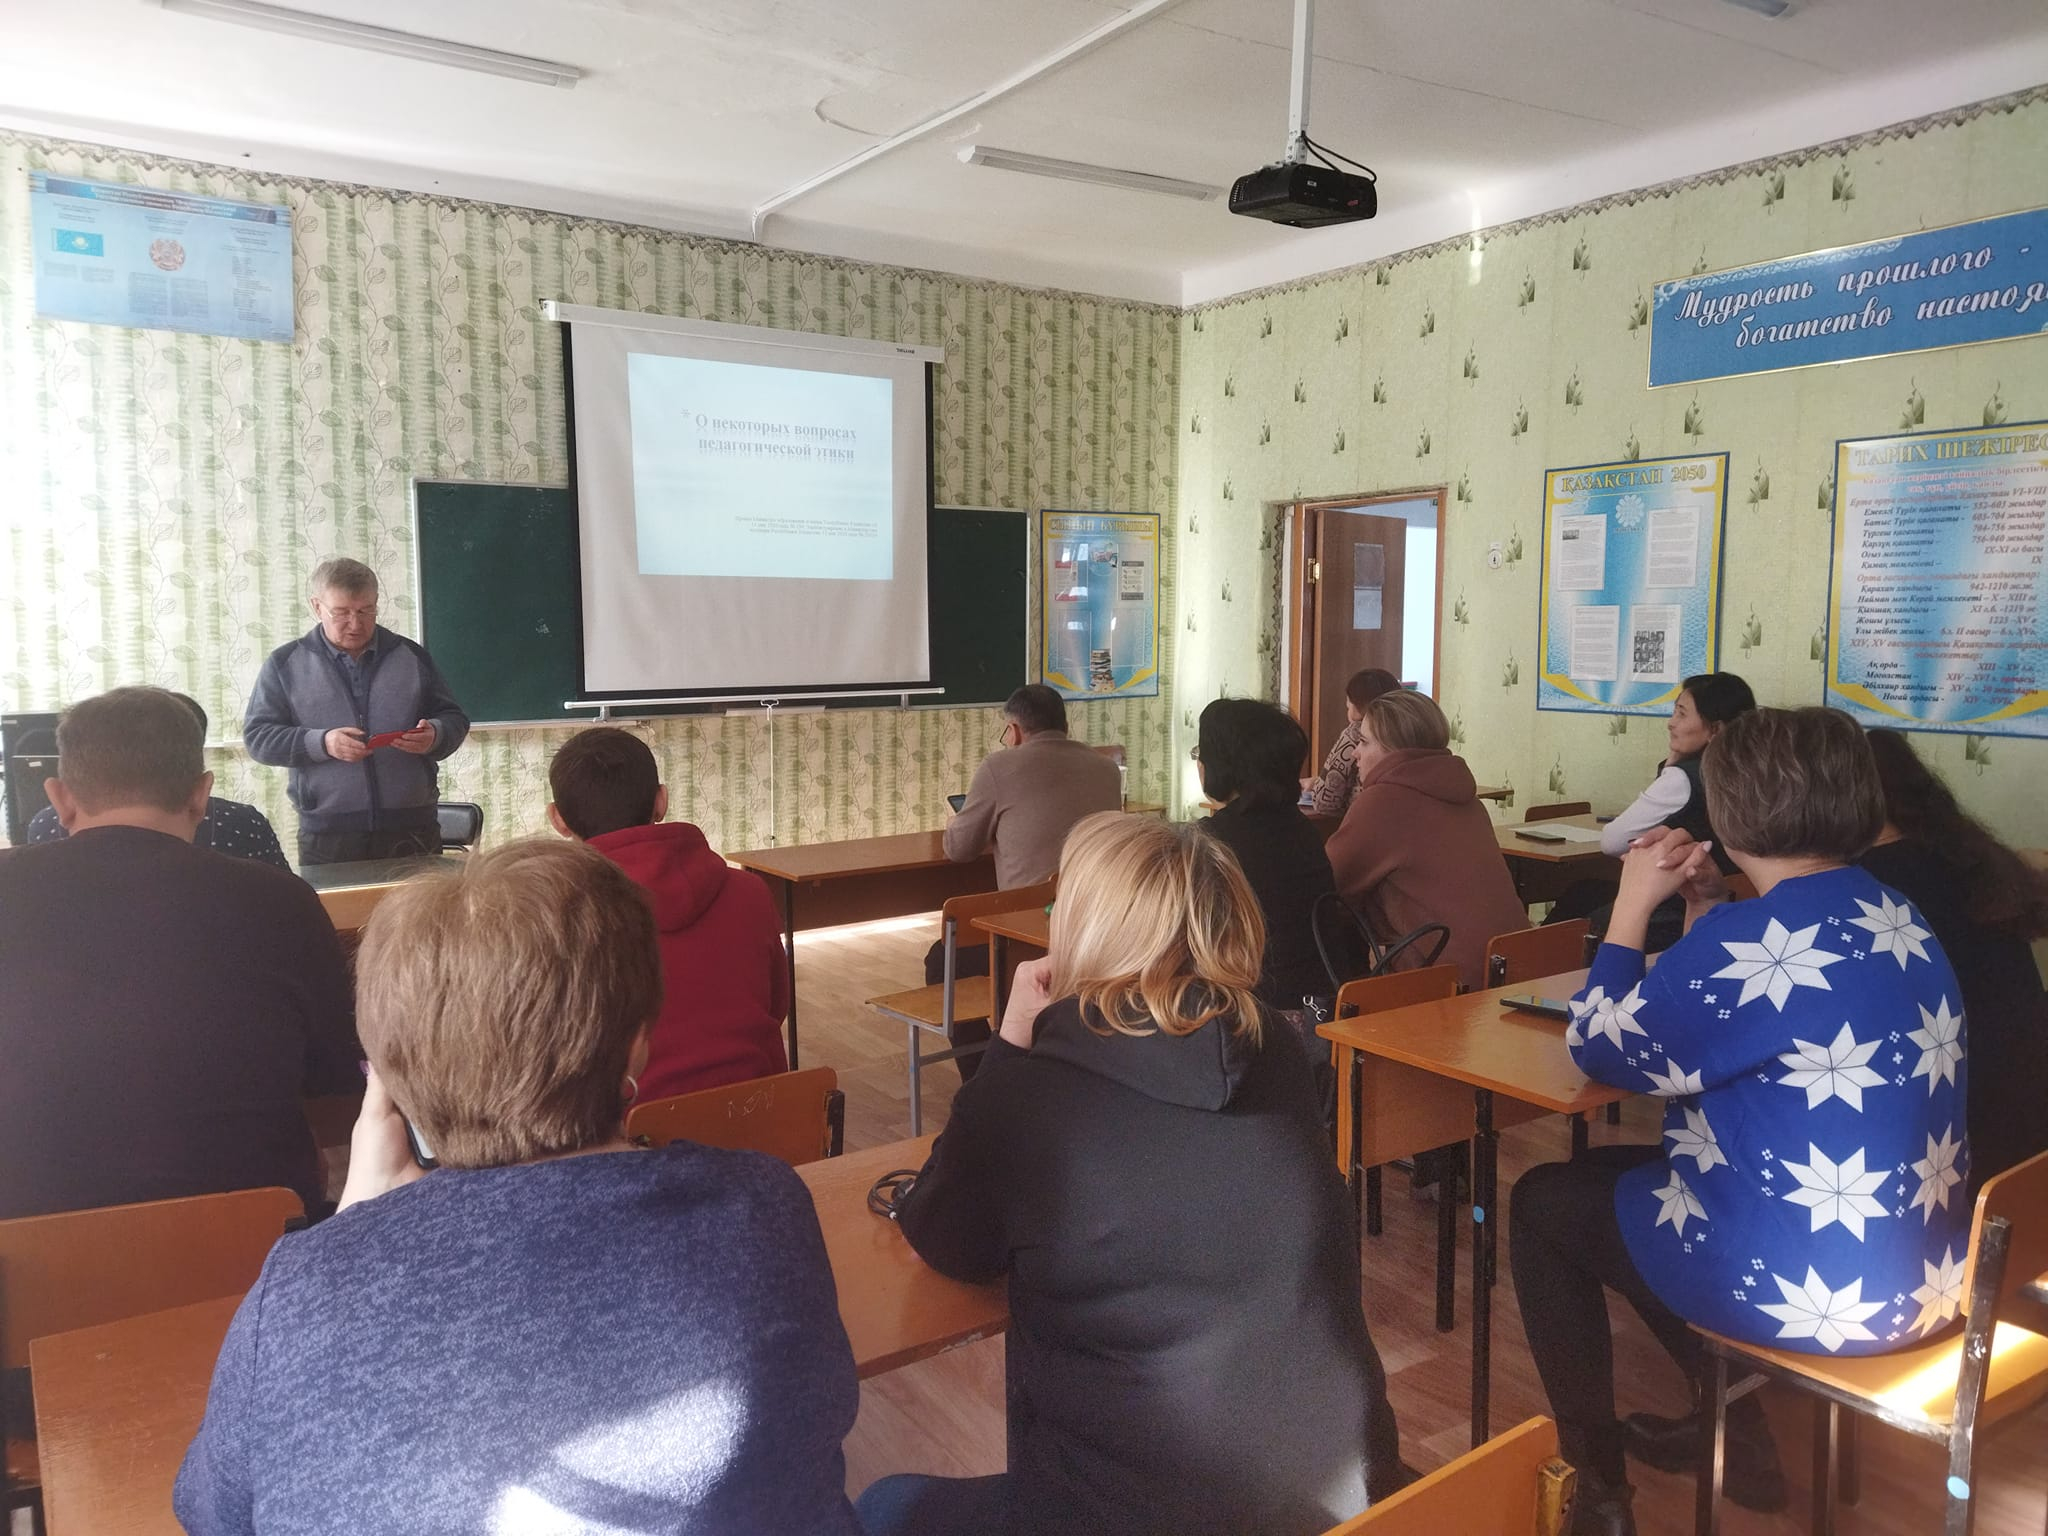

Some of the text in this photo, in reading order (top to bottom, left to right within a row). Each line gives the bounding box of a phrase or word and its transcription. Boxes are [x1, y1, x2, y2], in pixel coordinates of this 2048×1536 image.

[1674, 280, 1814, 327] Мудрость
[1838, 245, 1995, 298] прошлого
[1735, 281, 2048, 349] богатство настоя
[695, 413, 857, 440] О некоторых вопросах
[698, 438, 855, 460] педагогической этики
[1856, 444, 1929, 466] ТАРИХ
[1671, 464, 1707, 482] 2050
